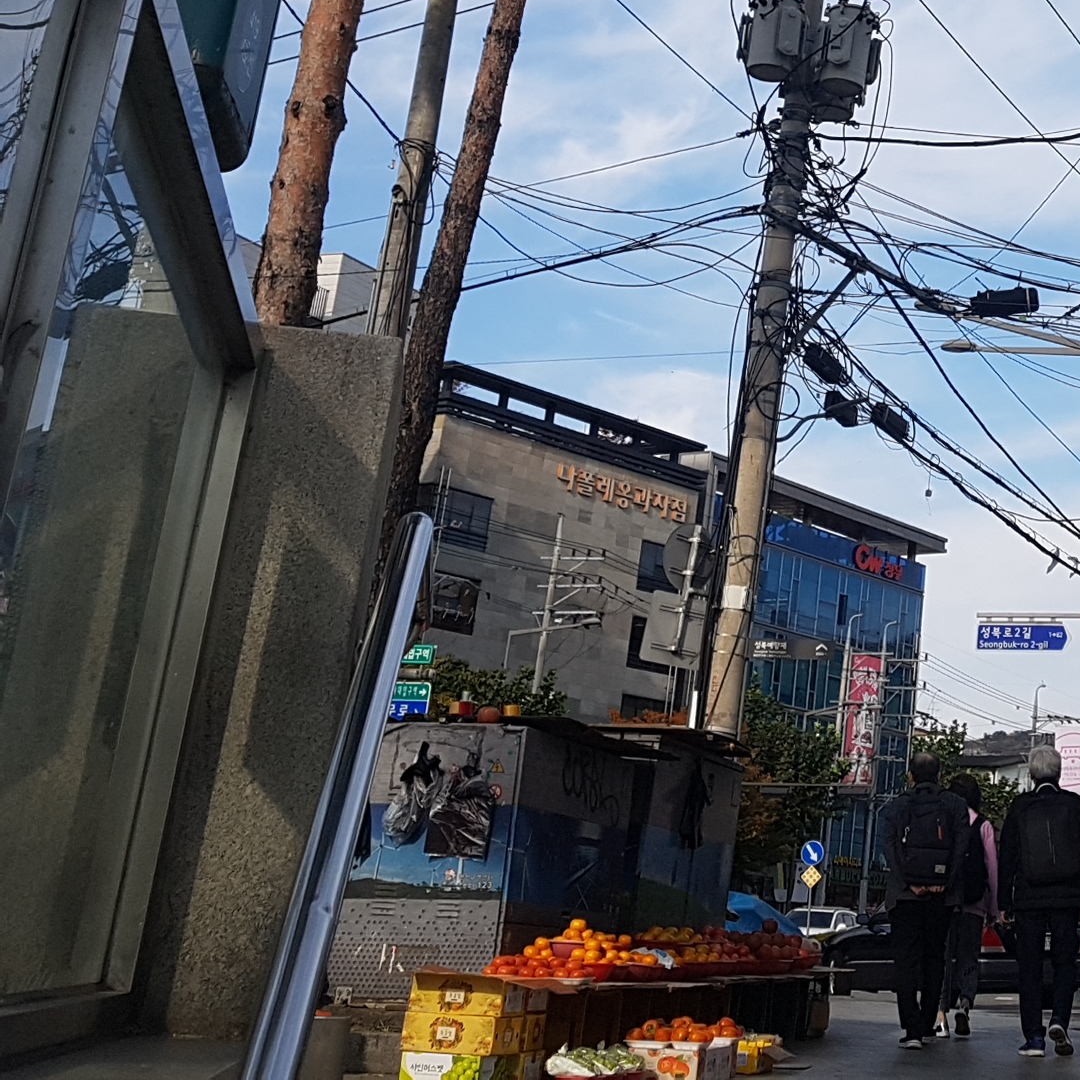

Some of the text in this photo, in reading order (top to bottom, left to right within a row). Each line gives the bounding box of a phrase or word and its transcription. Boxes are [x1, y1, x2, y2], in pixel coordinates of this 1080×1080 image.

[557, 463, 688, 524] 나폴레옹과자점
[980, 626, 1032, 640] 성북로2길
[979, 640, 1049, 651] Seongbuk-ro 2-gil
